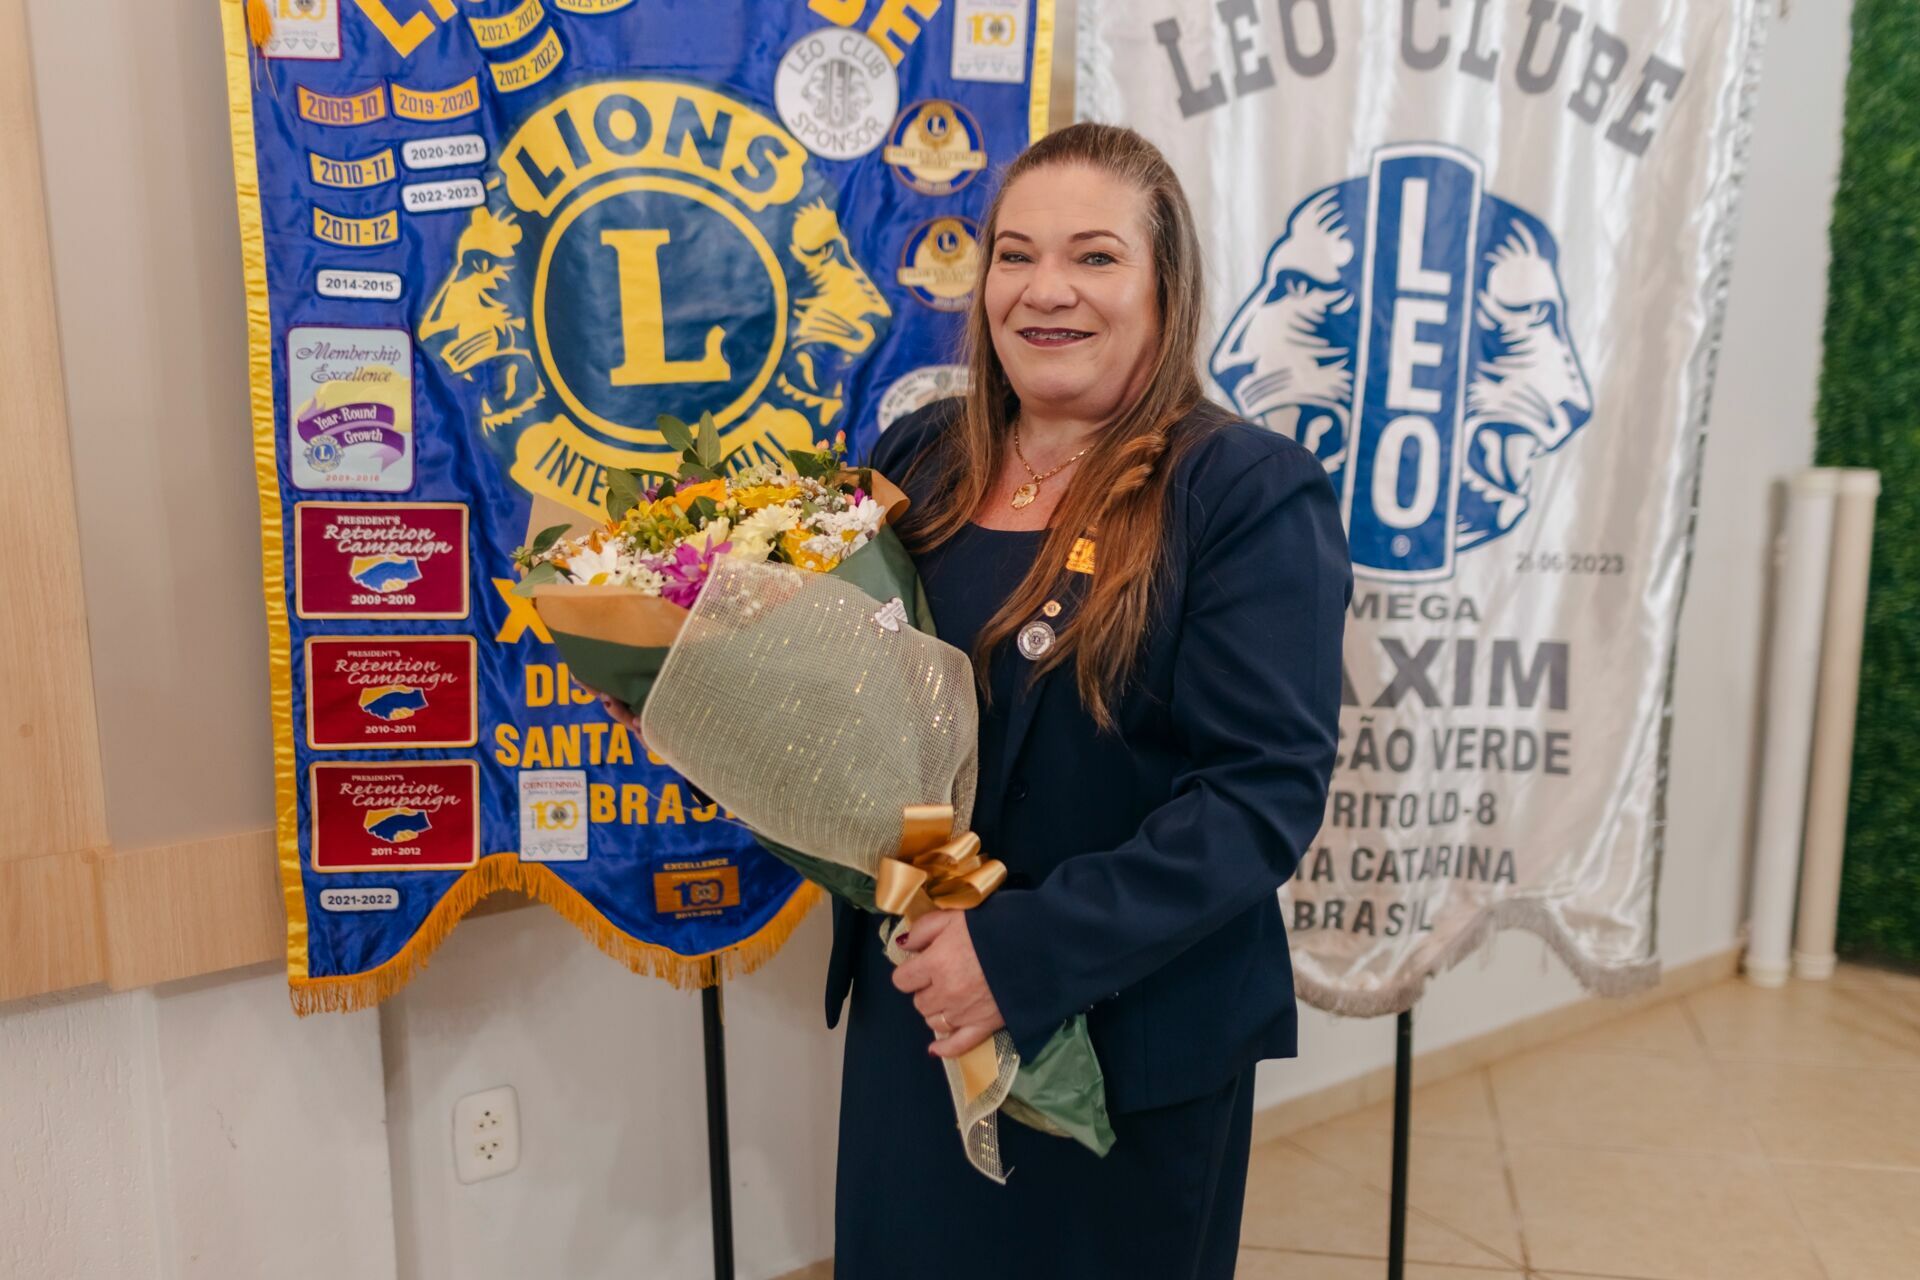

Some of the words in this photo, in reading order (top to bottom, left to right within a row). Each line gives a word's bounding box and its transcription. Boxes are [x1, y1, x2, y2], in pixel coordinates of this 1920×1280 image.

[478, 1, 541, 42] 2021-2022
[497, 41, 558, 86] 2022-2023
[786, 38, 826, 75] LEO
[840, 36, 887, 79] CLUB
[1153, 0, 1337, 119] LEO
[1400, 0, 1685, 157] CLUBE
[306, 94, 378, 124] 2009-10
[399, 89, 474, 115] 2019-2020
[790, 112, 884, 153] SPONSOR
[410, 142, 480, 161] 2020-2021
[516, 94, 789, 200] LIONS
[319, 157, 389, 185] 2010-11
[410, 186, 479, 204] 2022-2023
[320, 216, 391, 241] 2011-12
[325, 278, 394, 293] 2014-2015
[601, 229, 731, 386] L
[296, 341, 401, 365] Membership
[1371, 177, 1453, 529] LEO
[310, 363, 391, 384] Excellence
[343, 428, 383, 444] Growth
[323, 524, 436, 541] Retention
[338, 539, 453, 561] Campaign
[351, 595, 415, 605] 2009-2010
[1350, 593, 1481, 622] MEGA
[335, 657, 440, 673] Retention
[347, 671, 458, 690] Campaign
[365, 725, 418, 734] 2010-2011
[495, 723, 633, 768] SANTA
[1432, 727, 1571, 777] VERDE
[339, 781, 443, 797] Retention
[353, 793, 461, 812] Campaign
[528, 799, 579, 831] 100
[1331, 791, 1417, 830] RITO
[370, 847, 421, 856] 2011-2012
[1350, 847, 1518, 886] CATARINA
[327, 894, 393, 906] 2021-2022
[1292, 899, 1435, 938] BRASIL
